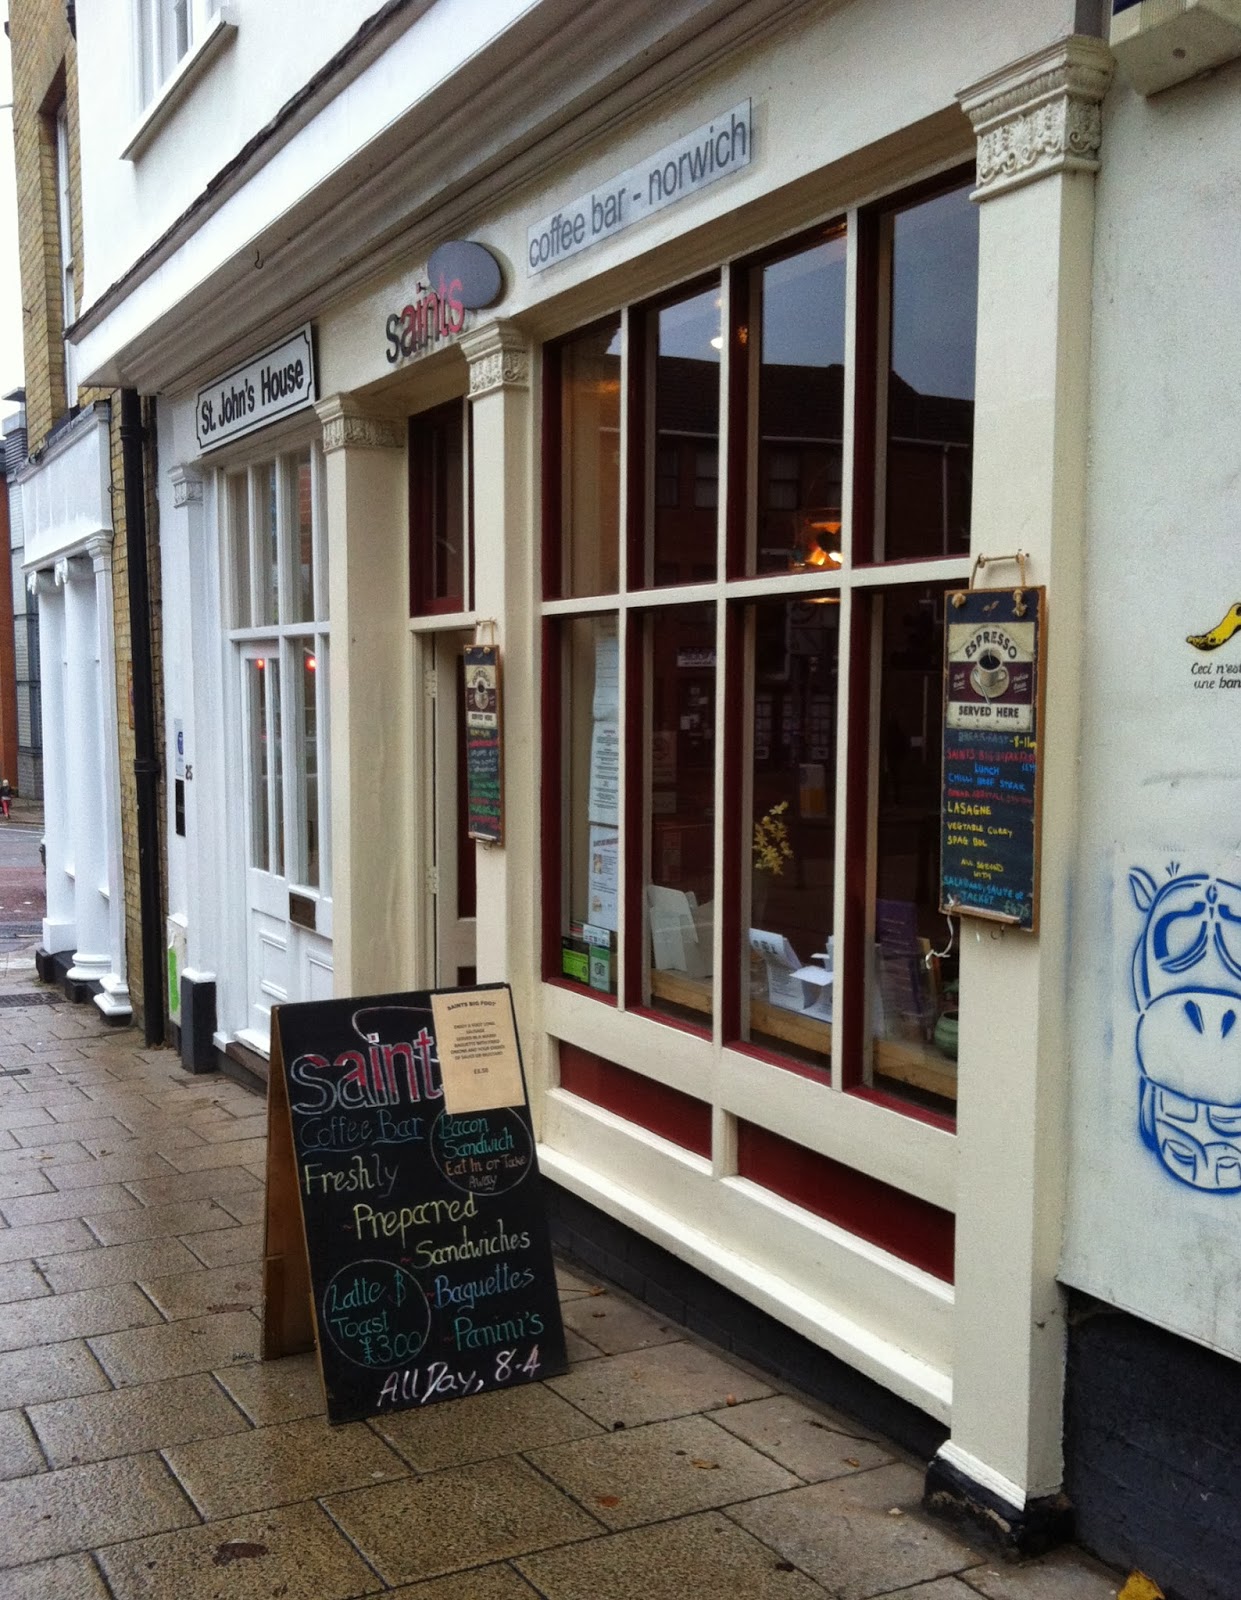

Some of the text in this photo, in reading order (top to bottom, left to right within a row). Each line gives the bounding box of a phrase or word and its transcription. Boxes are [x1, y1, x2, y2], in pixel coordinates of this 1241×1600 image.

[529, 210, 585, 268] coffee
[591, 194, 628, 236] bar
[649, 113, 747, 205] norwich
[386, 271, 465, 364] saints
[201, 359, 304, 435] St. John's House
[965, 631, 1017, 659] ESPRESSO
[1191, 662, 1213, 675] Ceci
[1194, 680, 1215, 689] une
[959, 706, 1020, 718] SERVED HERE
[974, 762, 1000, 775] LUNCH
[947, 801, 992, 815] LASAGNE
[947, 835, 969, 846] SPAG
[291, 1026, 443, 1115] saint
[301, 1109, 424, 1149] Coffee Bar
[439, 1114, 490, 1139] Bacon
[443, 1127, 515, 1159] Sandwich
[304, 1154, 399, 1198] Freshly
[446, 1153, 526, 1176] Eat In or Take
[469, 1175, 497, 1191] Away
[353, 1192, 479, 1249] Prepared
[411, 1219, 531, 1269] Sandwiches
[331, 1278, 386, 1312] Latte
[434, 1262, 535, 1312] Baguettes
[330, 1309, 388, 1339] Toast
[454, 1311, 545, 1351] Panini's
[376, 1367, 418, 1407] All
